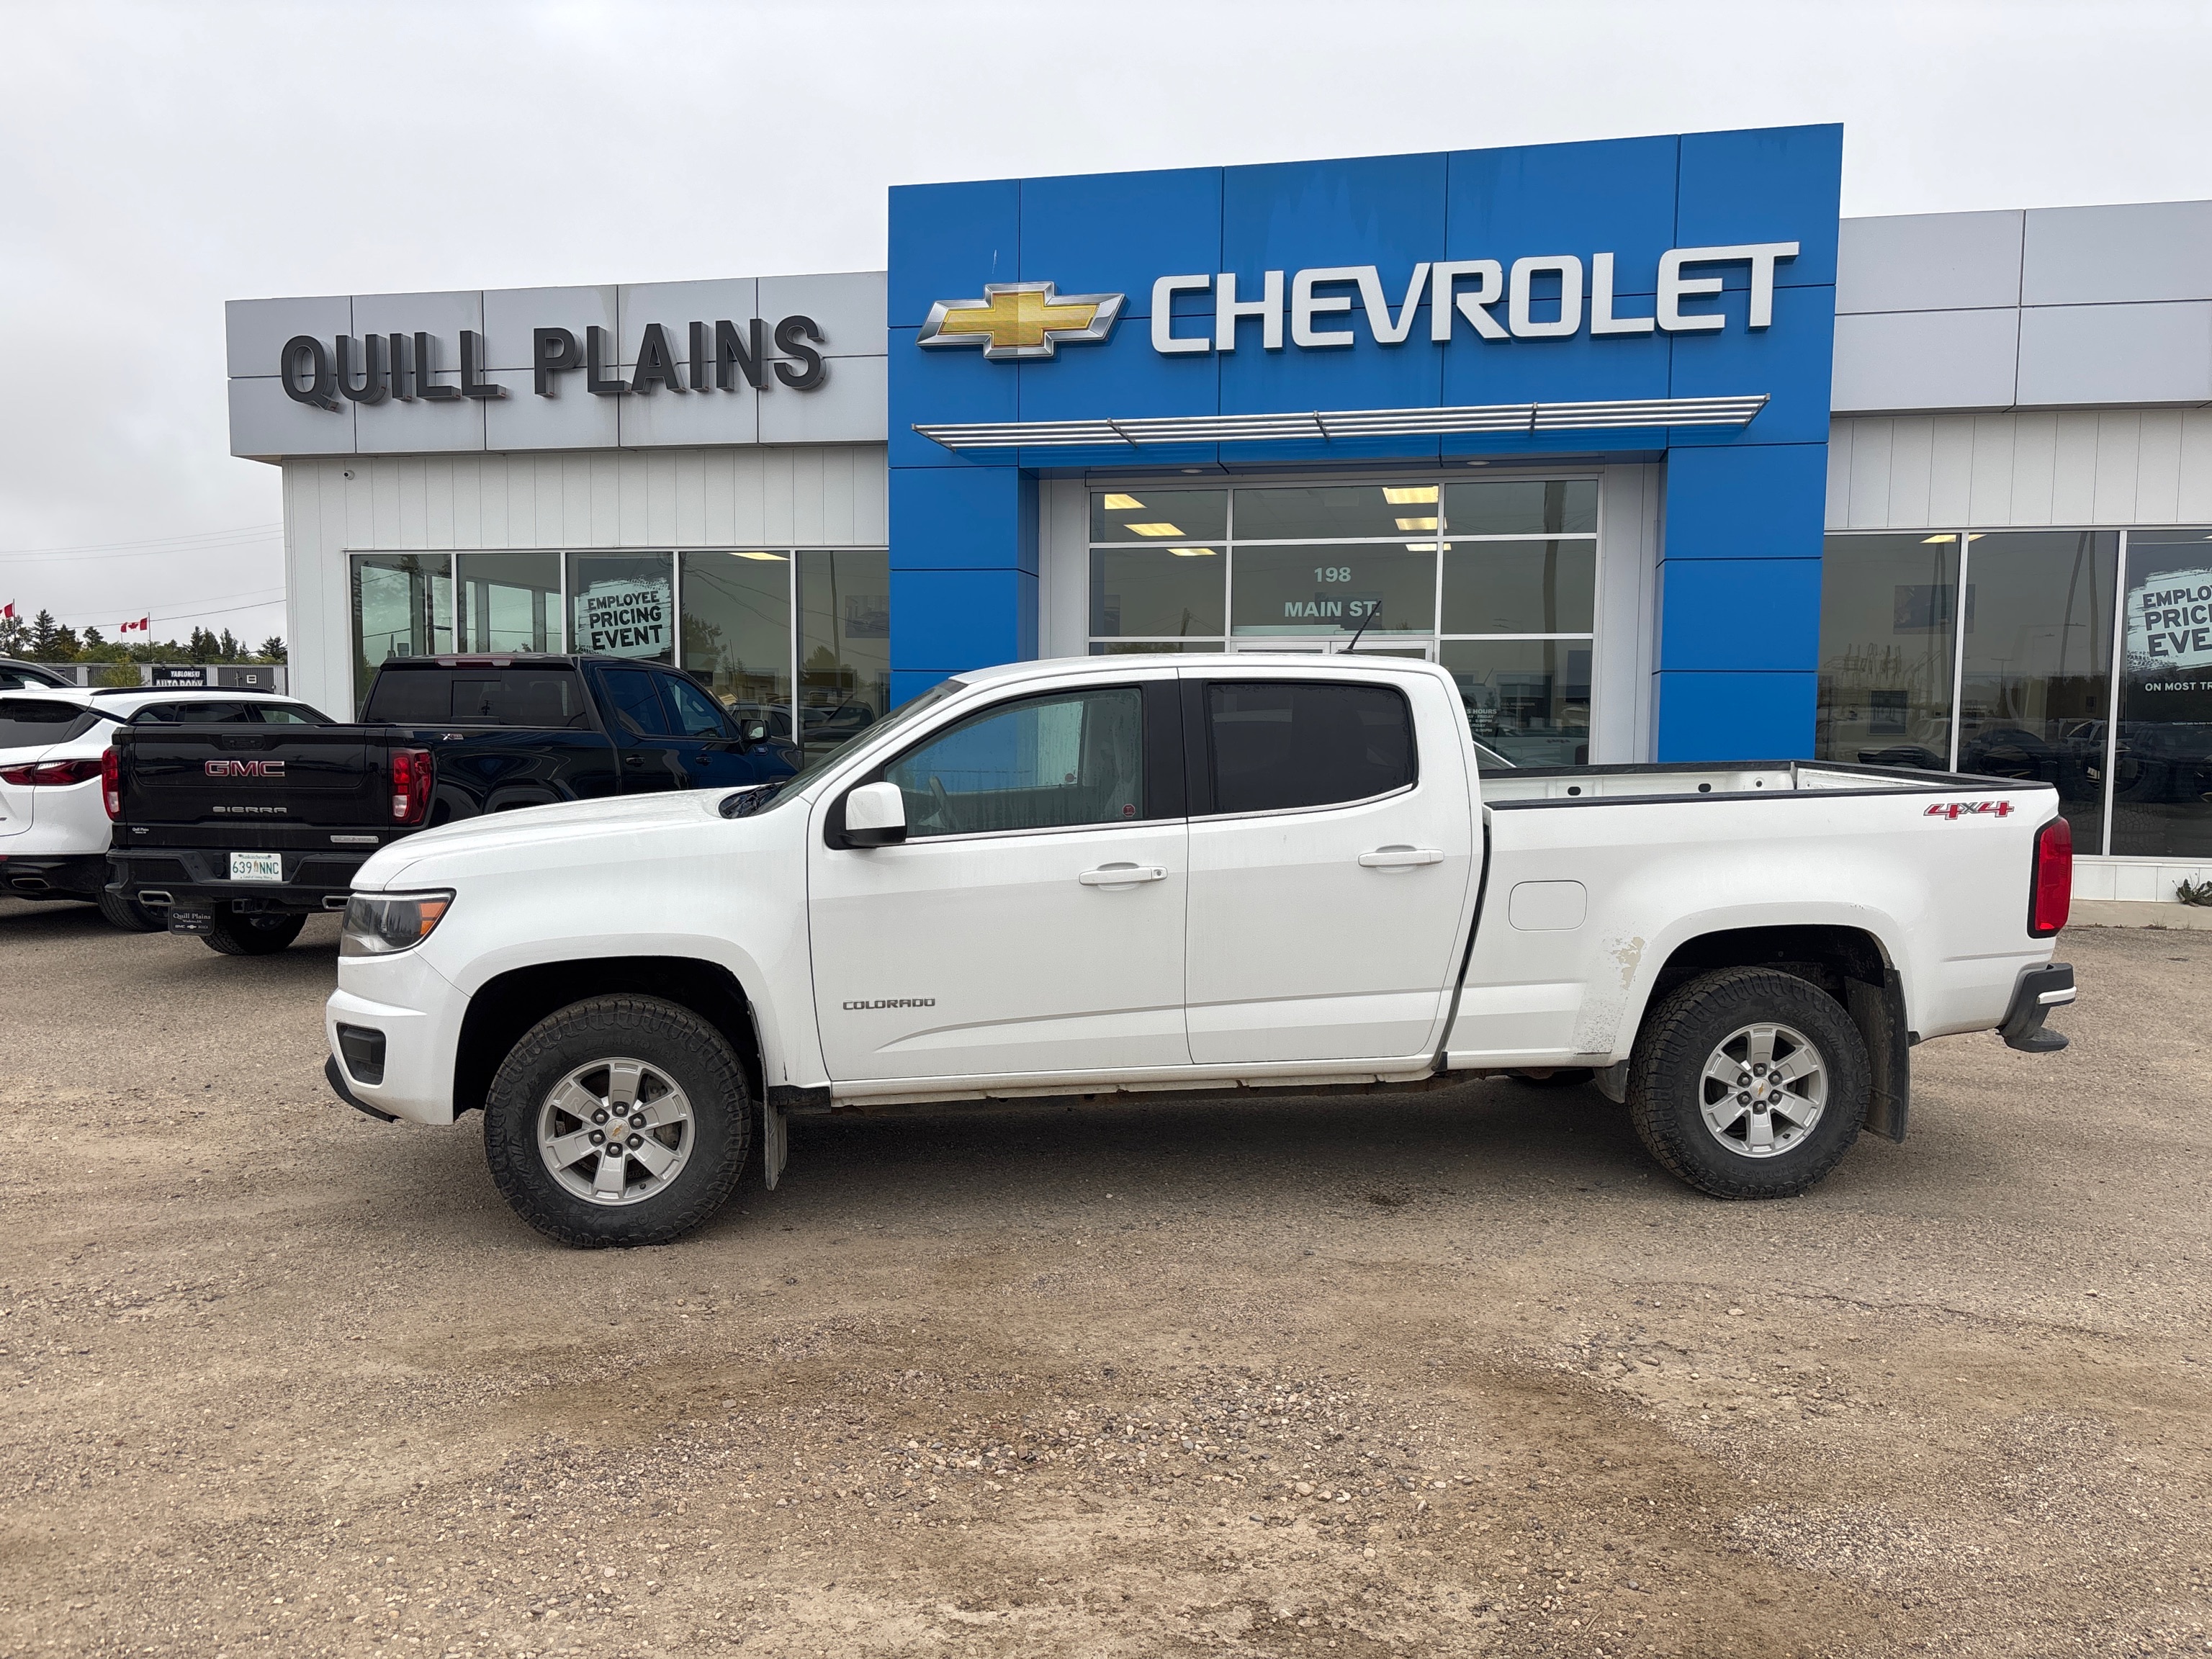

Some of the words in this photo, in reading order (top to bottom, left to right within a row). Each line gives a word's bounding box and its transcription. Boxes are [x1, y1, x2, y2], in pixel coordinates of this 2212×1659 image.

[1151, 241, 1800, 354] CHEVROLET
[281, 330, 505, 412] QUILL
[533, 315, 825, 396] PLAINS
[1314, 567, 1352, 582] 198
[588, 590, 660, 610] EMPLOYEE
[1285, 601, 1341, 616] MAIN
[1349, 601, 1380, 616] ST.
[589, 606, 662, 629] PRICING
[591, 624, 662, 650] EVENT
[2164, 683, 2196, 691] MOST
[204, 760, 285, 777] GMC
[233, 860, 252, 873] 639
[259, 861, 279, 874] NNC
[843, 998, 935, 1010] COLORADO
